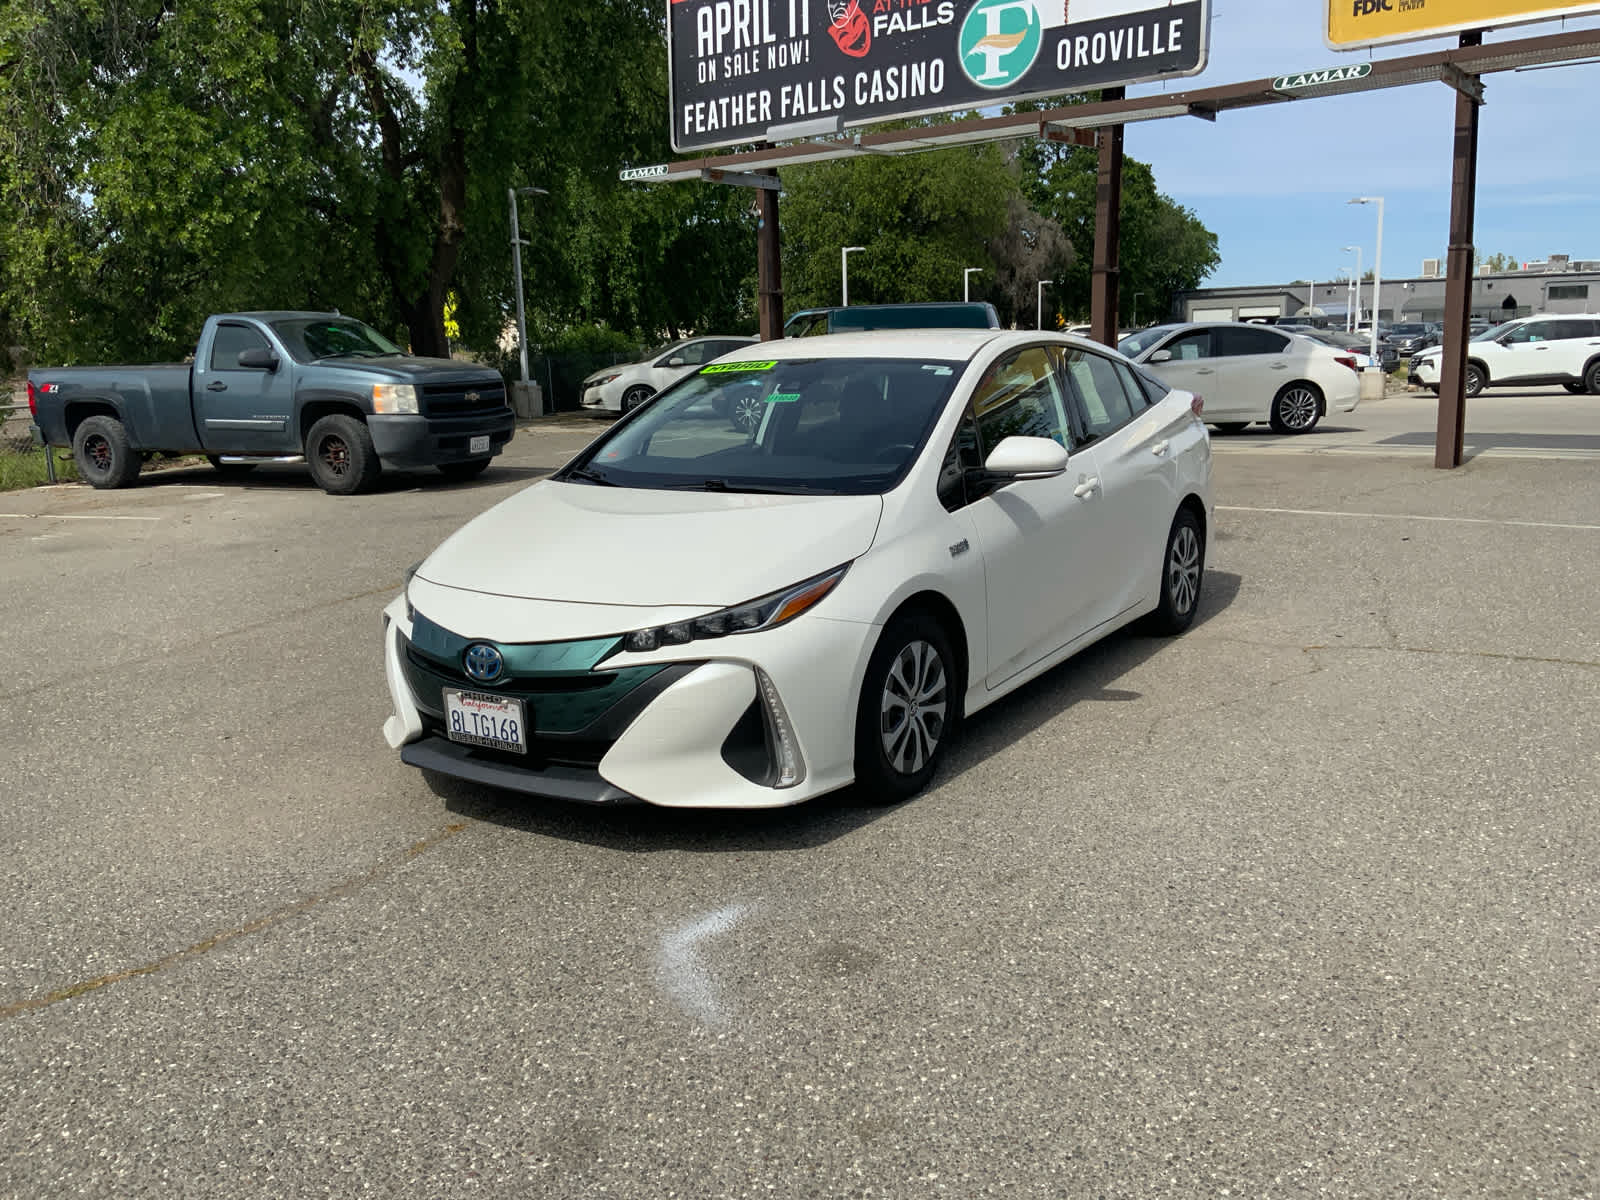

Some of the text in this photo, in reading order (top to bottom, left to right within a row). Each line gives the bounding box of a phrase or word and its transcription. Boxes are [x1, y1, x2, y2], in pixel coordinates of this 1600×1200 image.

[873, 1, 955, 38] FALLS
[1353, 0, 1393, 16] FDIC
[697, 0, 776, 58] APRIL
[1056, 18, 1183, 71] OROVILLE
[698, 39, 809, 84] ON SALE NOW!
[1280, 65, 1362, 89] LAMAR
[684, 58, 945, 135] FEATHER FALLS CASINO
[624, 165, 665, 180] LAMAR
[451, 709, 519, 743] 8LTG168
